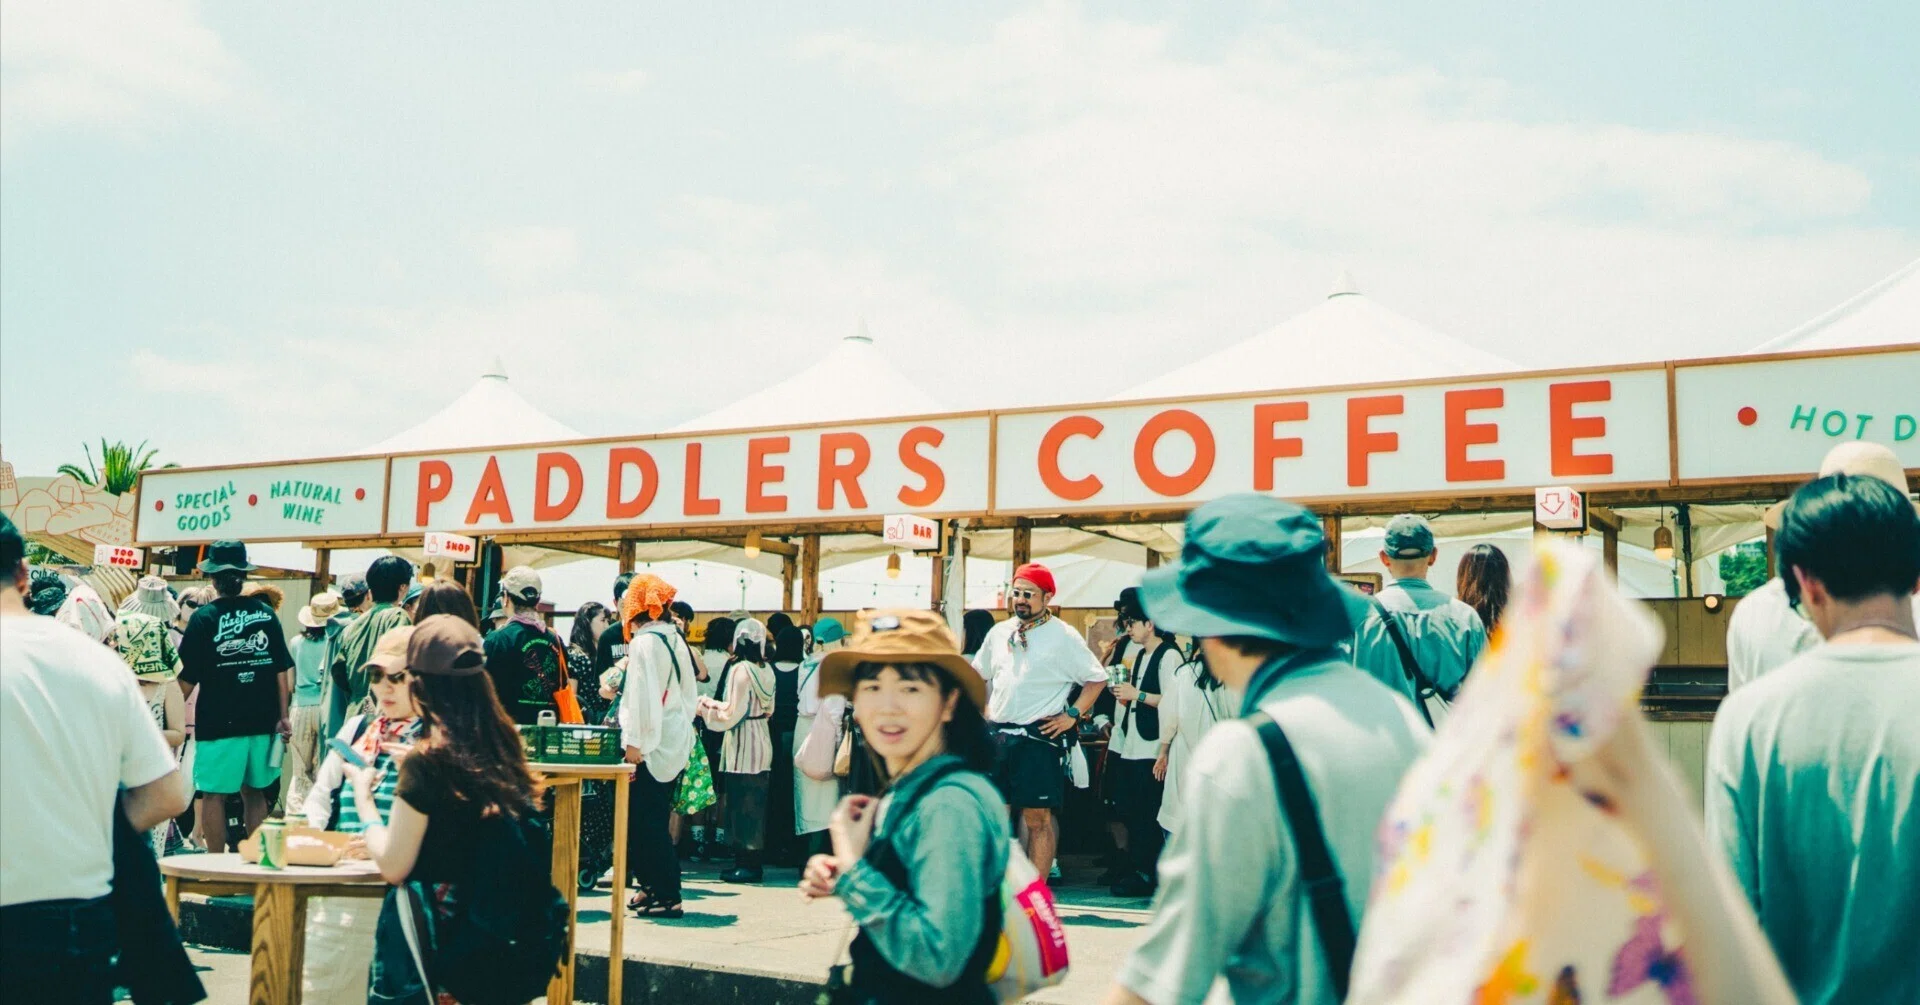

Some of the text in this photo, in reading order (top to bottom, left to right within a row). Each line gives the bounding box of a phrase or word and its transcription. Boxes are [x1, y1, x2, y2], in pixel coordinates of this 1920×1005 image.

[1789, 404, 1918, 442] HOT D
[415, 380, 1615, 527] PADDLERS COFFEE
[174, 480, 237, 509] SPECIAL
[269, 480, 343, 505] NATURAL
[176, 504, 232, 532] GOODS
[282, 502, 325, 526] WINE
[912, 523, 932, 539] BAR
[114, 548, 134, 557] TOO
[445, 540, 471, 554] SHOP
[109, 556, 139, 567] WOOD
